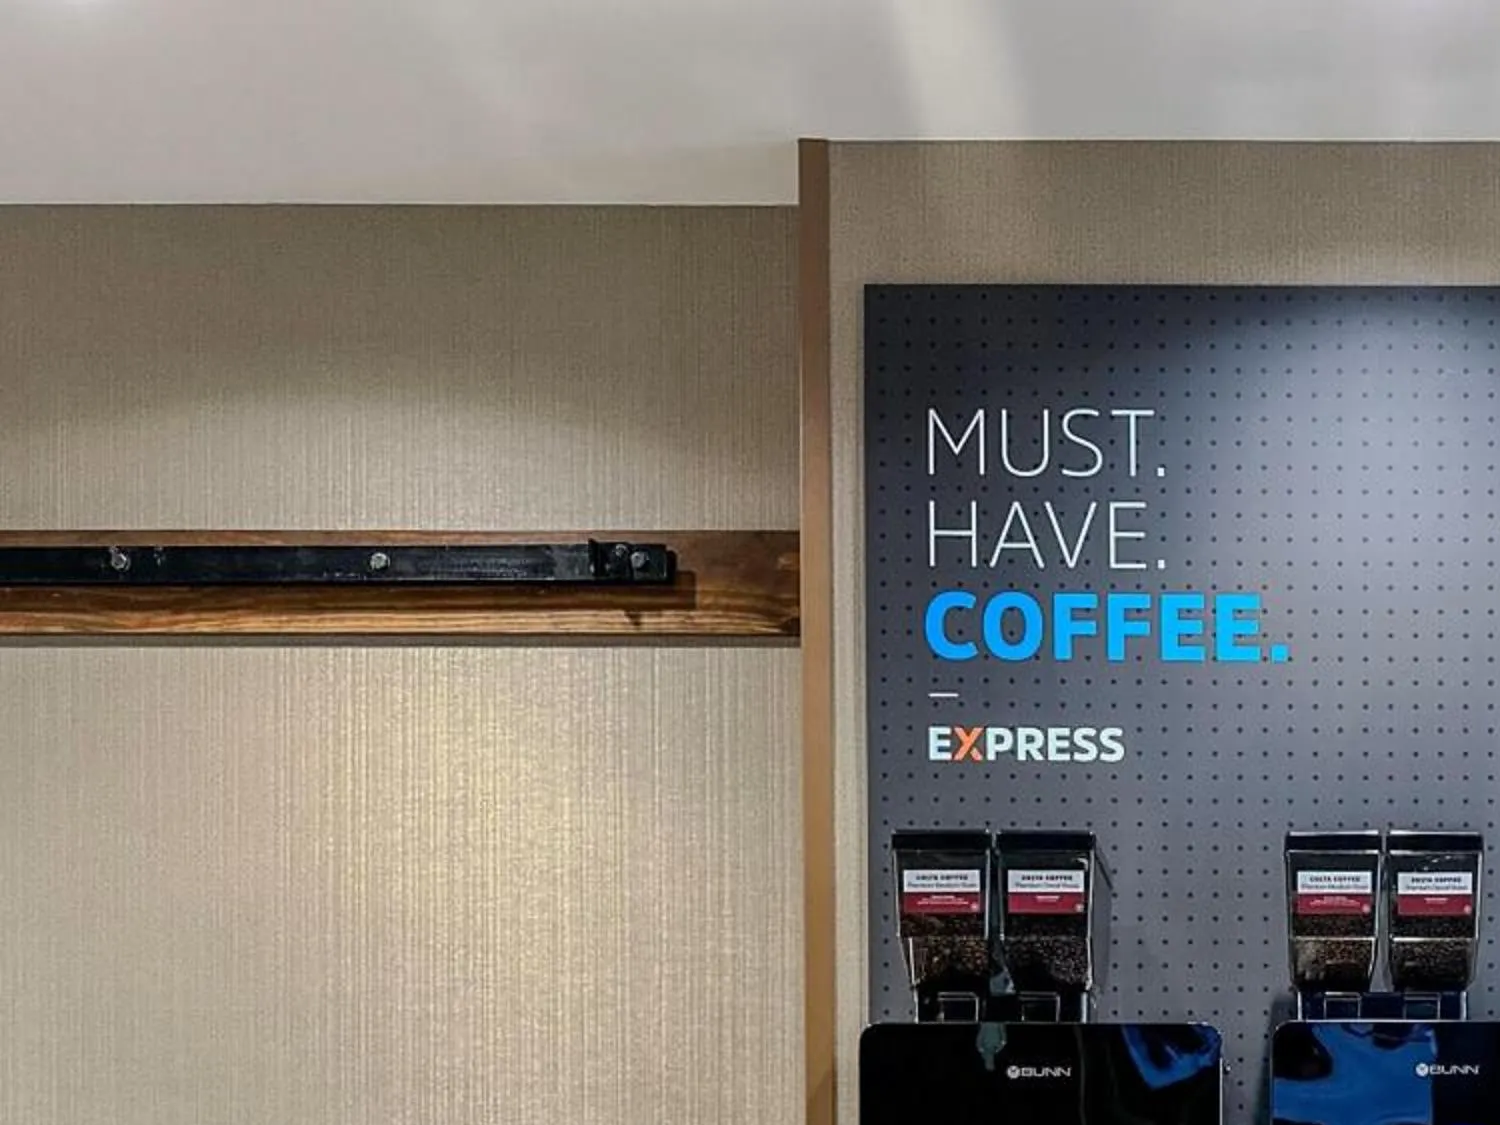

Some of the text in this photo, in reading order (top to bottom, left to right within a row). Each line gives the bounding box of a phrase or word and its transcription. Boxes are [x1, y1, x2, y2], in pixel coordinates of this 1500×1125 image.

[928, 408, 1166, 478] MUST.
[928, 500, 1166, 569] HAVE.
[924, 590, 1290, 663] COFFEE.
[927, 725, 1126, 762] EXPRESS
[1021, 1066, 1072, 1078] BUNN
[1429, 1064, 1480, 1076] BUNN
